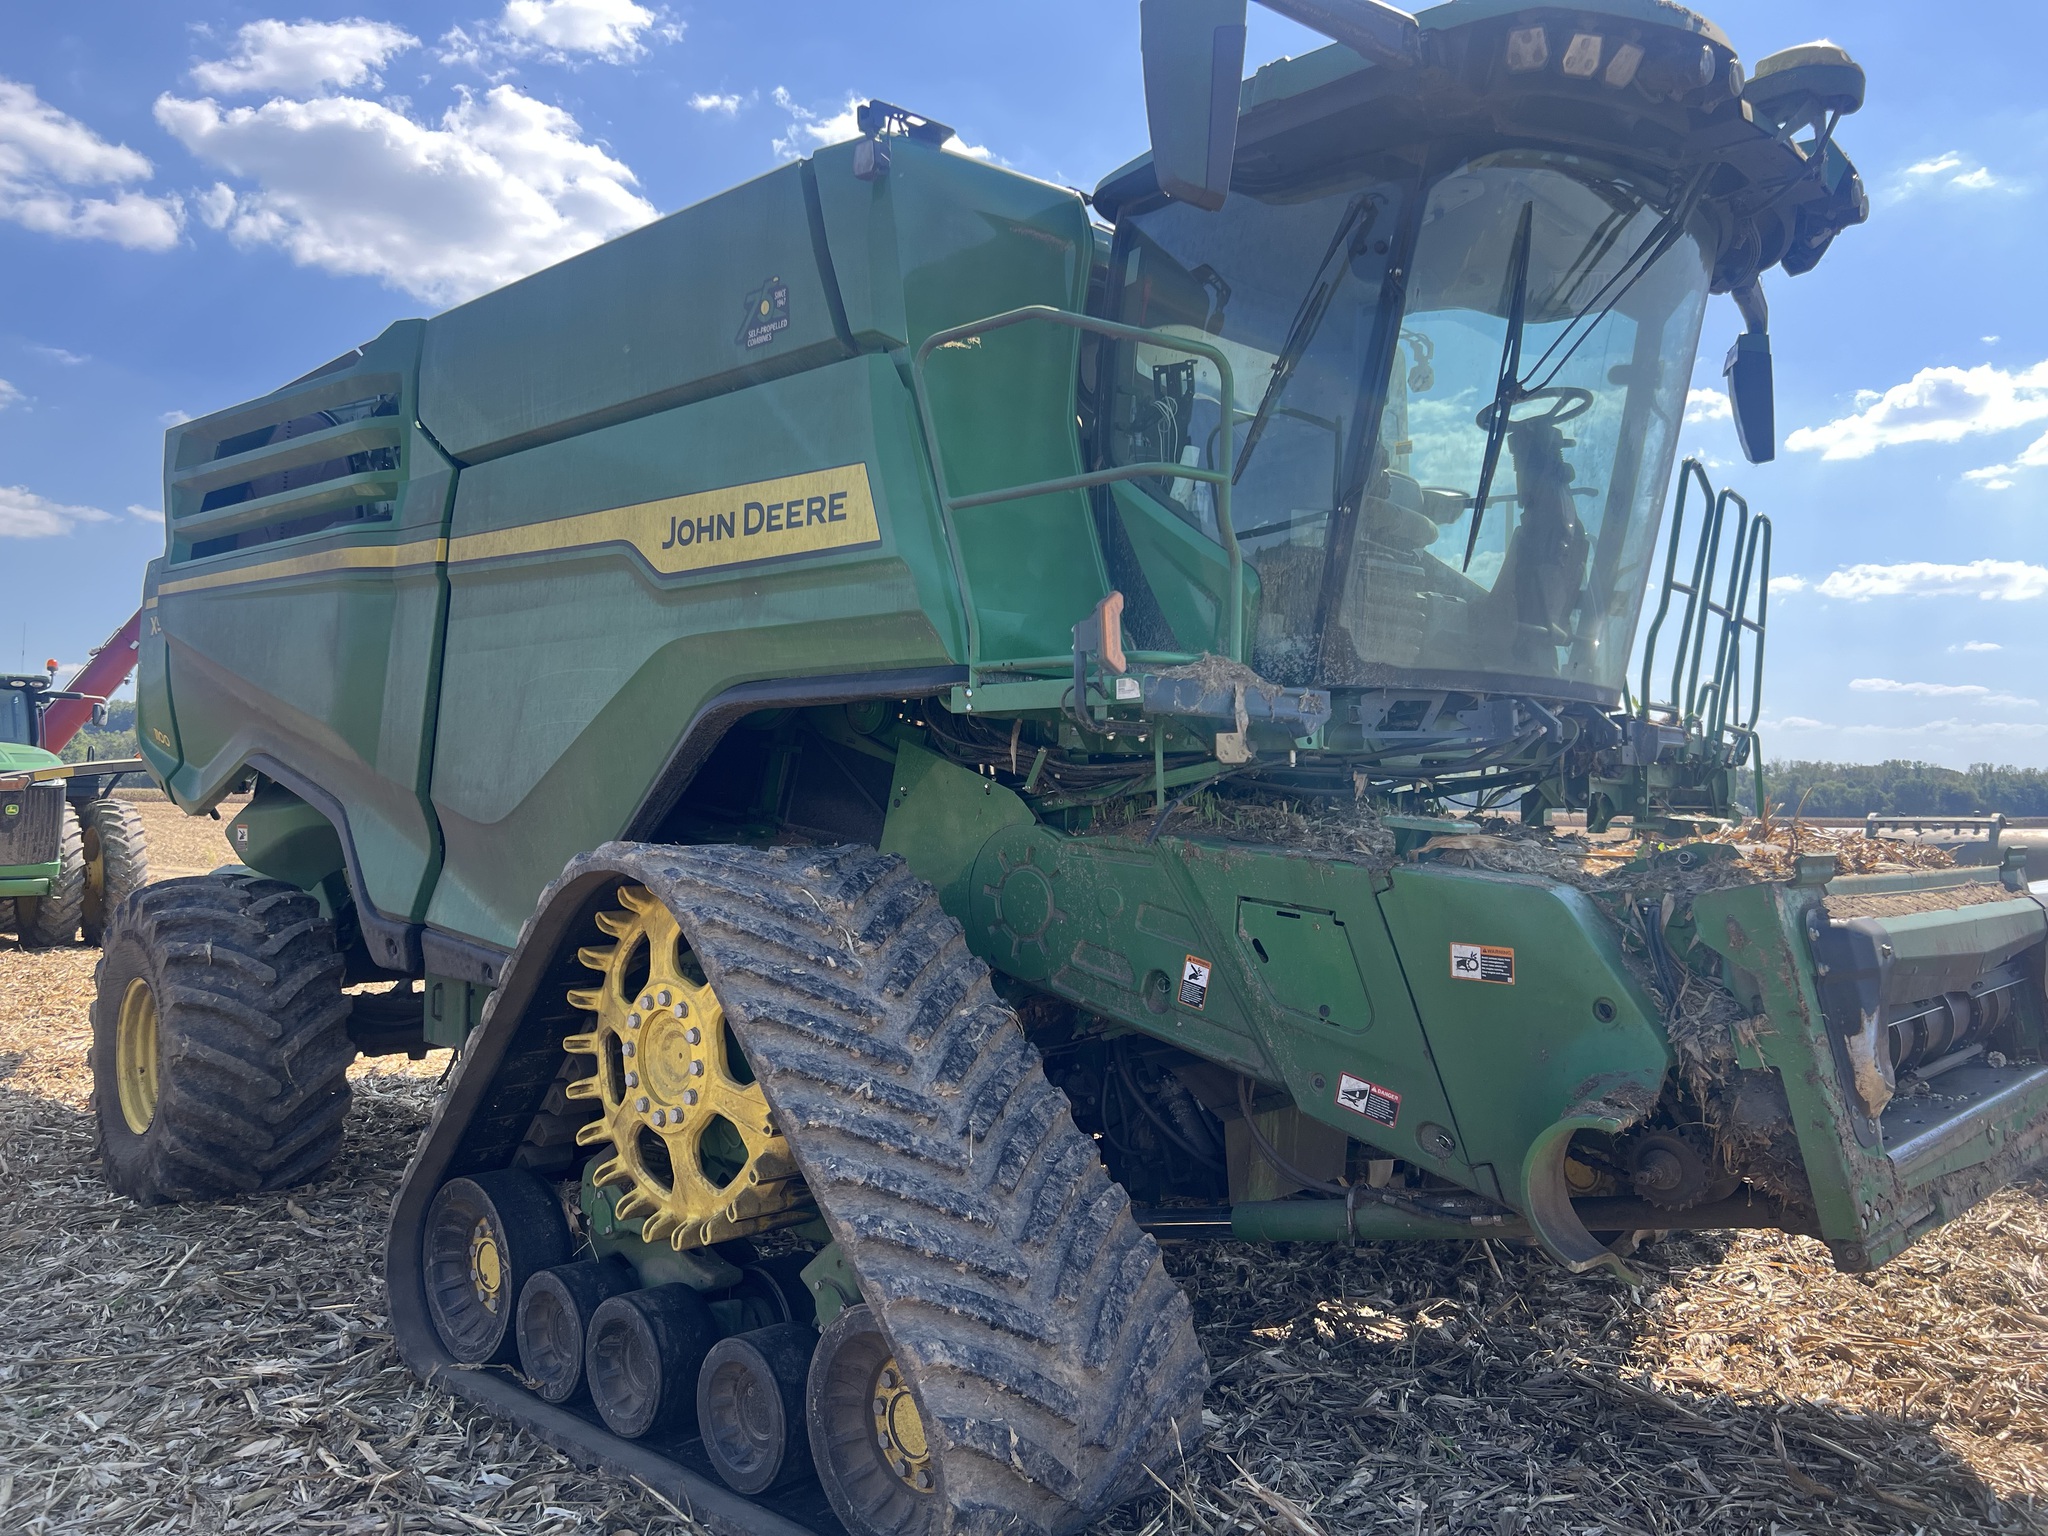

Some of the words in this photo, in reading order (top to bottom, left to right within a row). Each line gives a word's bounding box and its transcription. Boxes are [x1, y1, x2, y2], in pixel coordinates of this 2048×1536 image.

[774, 288, 787, 300] SINCE
[747, 319, 788, 339] SELF-PROPELLED
[747, 333, 772, 347] COMBINES
[662, 511, 735, 550] JOHN
[743, 491, 848, 537] DEERE
[1377, 1088, 1399, 1101] DANGER
